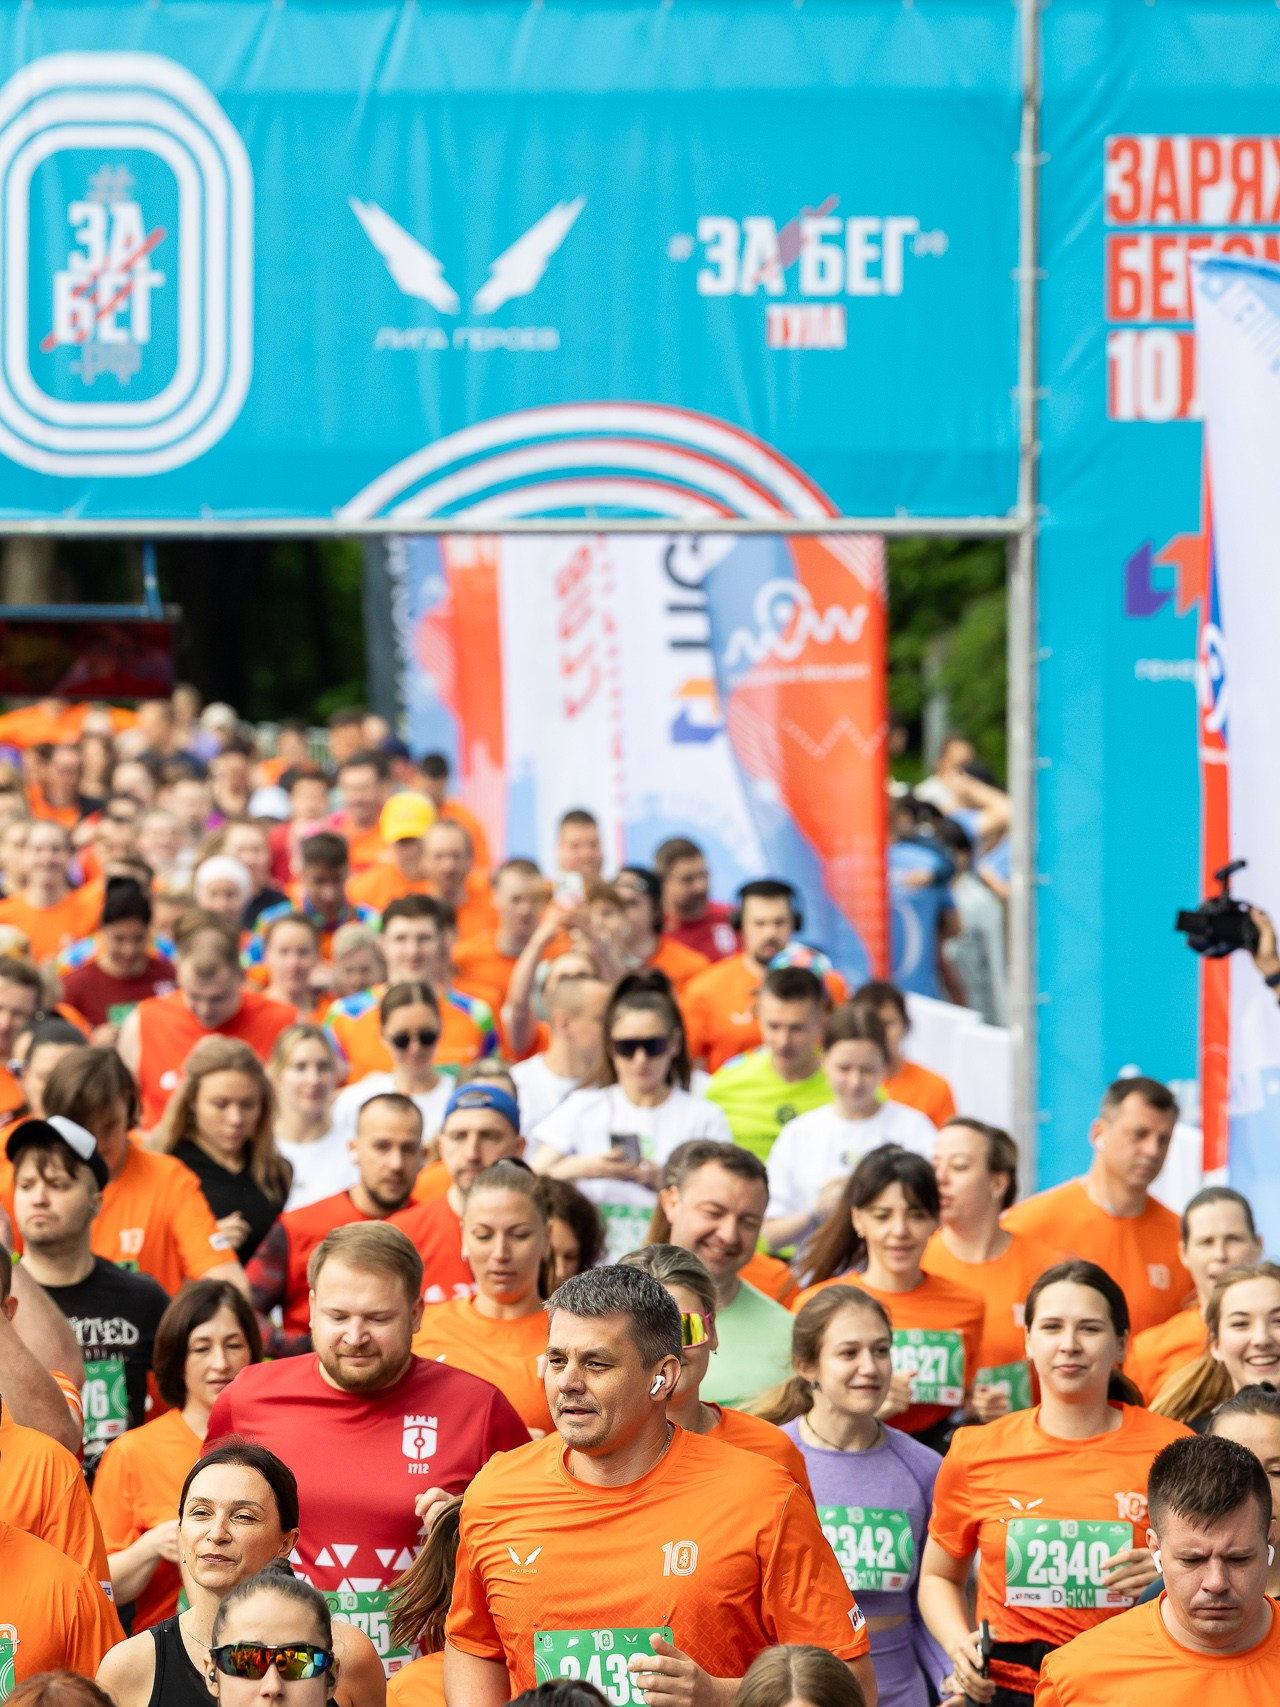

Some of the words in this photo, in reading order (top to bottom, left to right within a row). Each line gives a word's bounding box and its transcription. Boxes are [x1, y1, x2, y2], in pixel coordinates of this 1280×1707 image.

[1104, 134, 1280, 226] ЗАРЯ
[68, 200, 150, 272] ЗА
[52, 268, 167, 346] БЕГ
[1107, 327, 1183, 424] 10
[67, 1315, 140, 1347] ITED
[407, 1462, 430, 1475] 1712
[662, 1539, 699, 1577] 10
[821, 1523, 897, 1570] 2342
[1026, 1538, 1110, 1587] 2340
[1052, 1589, 1063, 1604] D
[1066, 1588, 1097, 1608] 5KM
[331, 1611, 391, 1657] 75
[590, 1629, 615, 1652] 10
